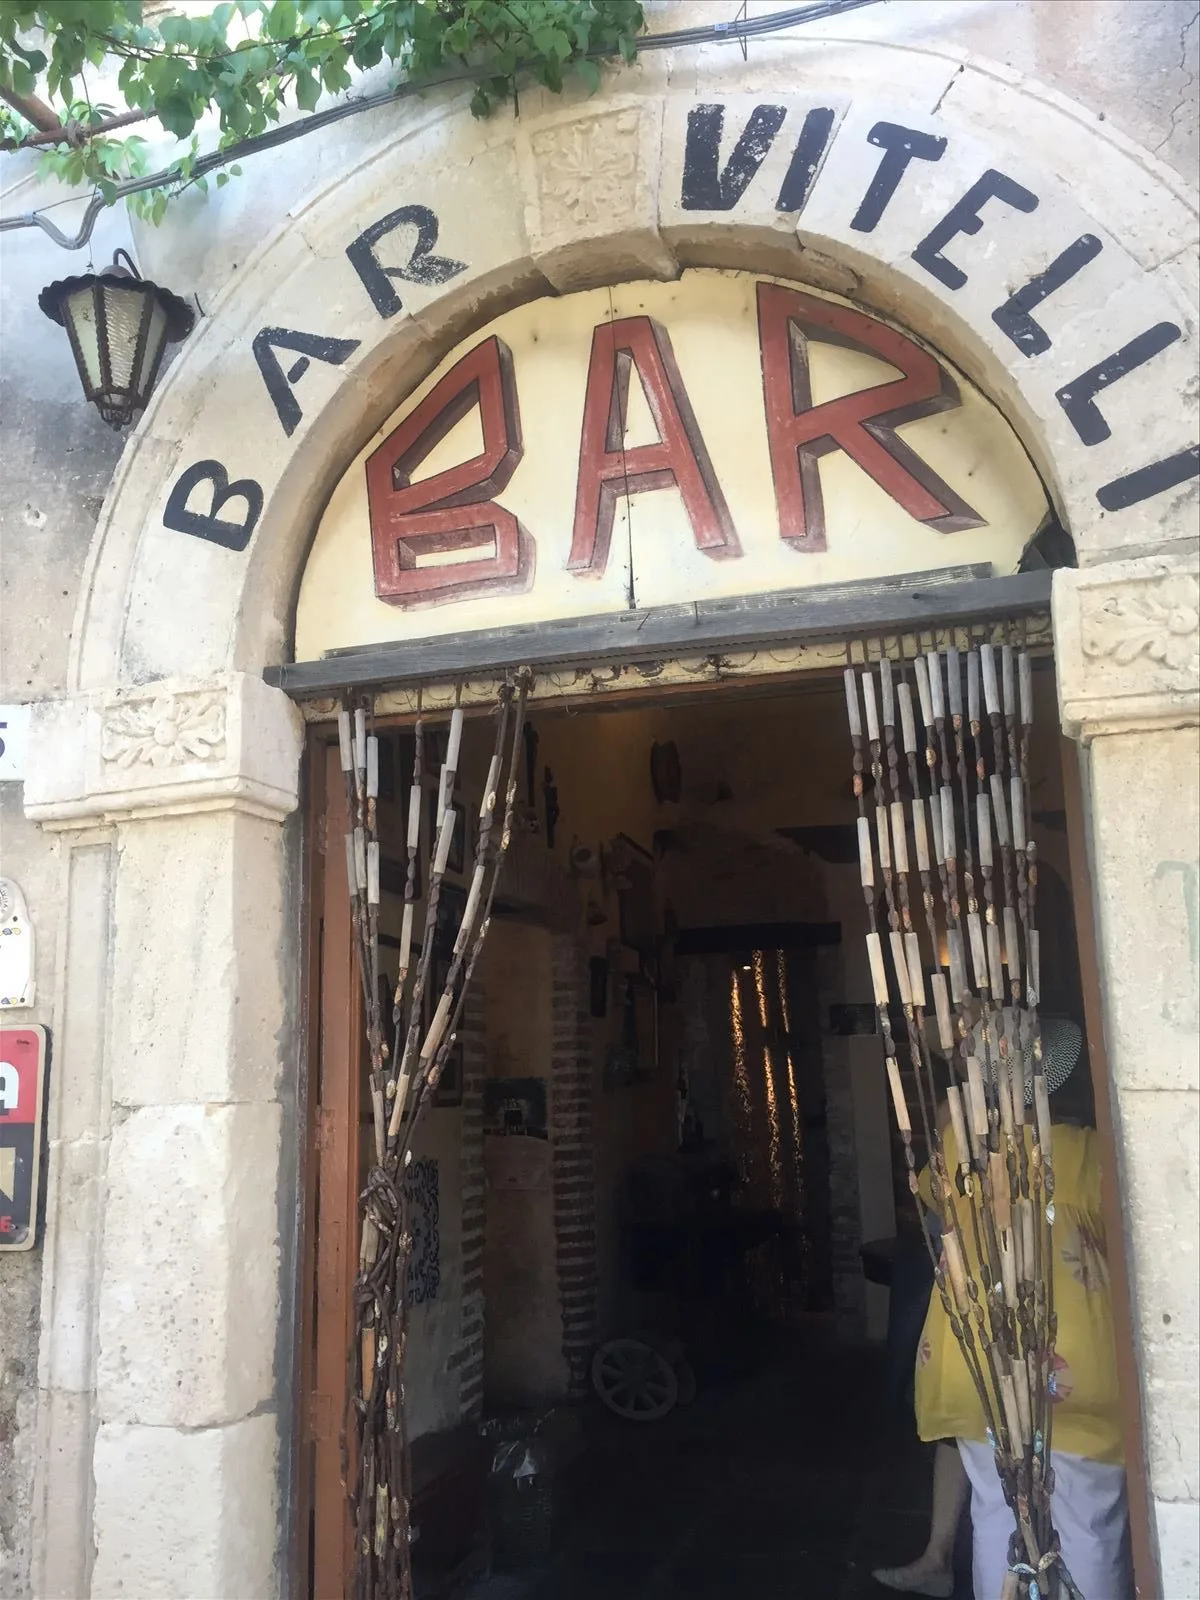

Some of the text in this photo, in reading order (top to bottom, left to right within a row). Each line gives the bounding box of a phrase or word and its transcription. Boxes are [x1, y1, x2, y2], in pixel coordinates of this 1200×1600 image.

[163, 103, 1200, 552] BAR VITELLI
[366, 281, 988, 611] BAR
